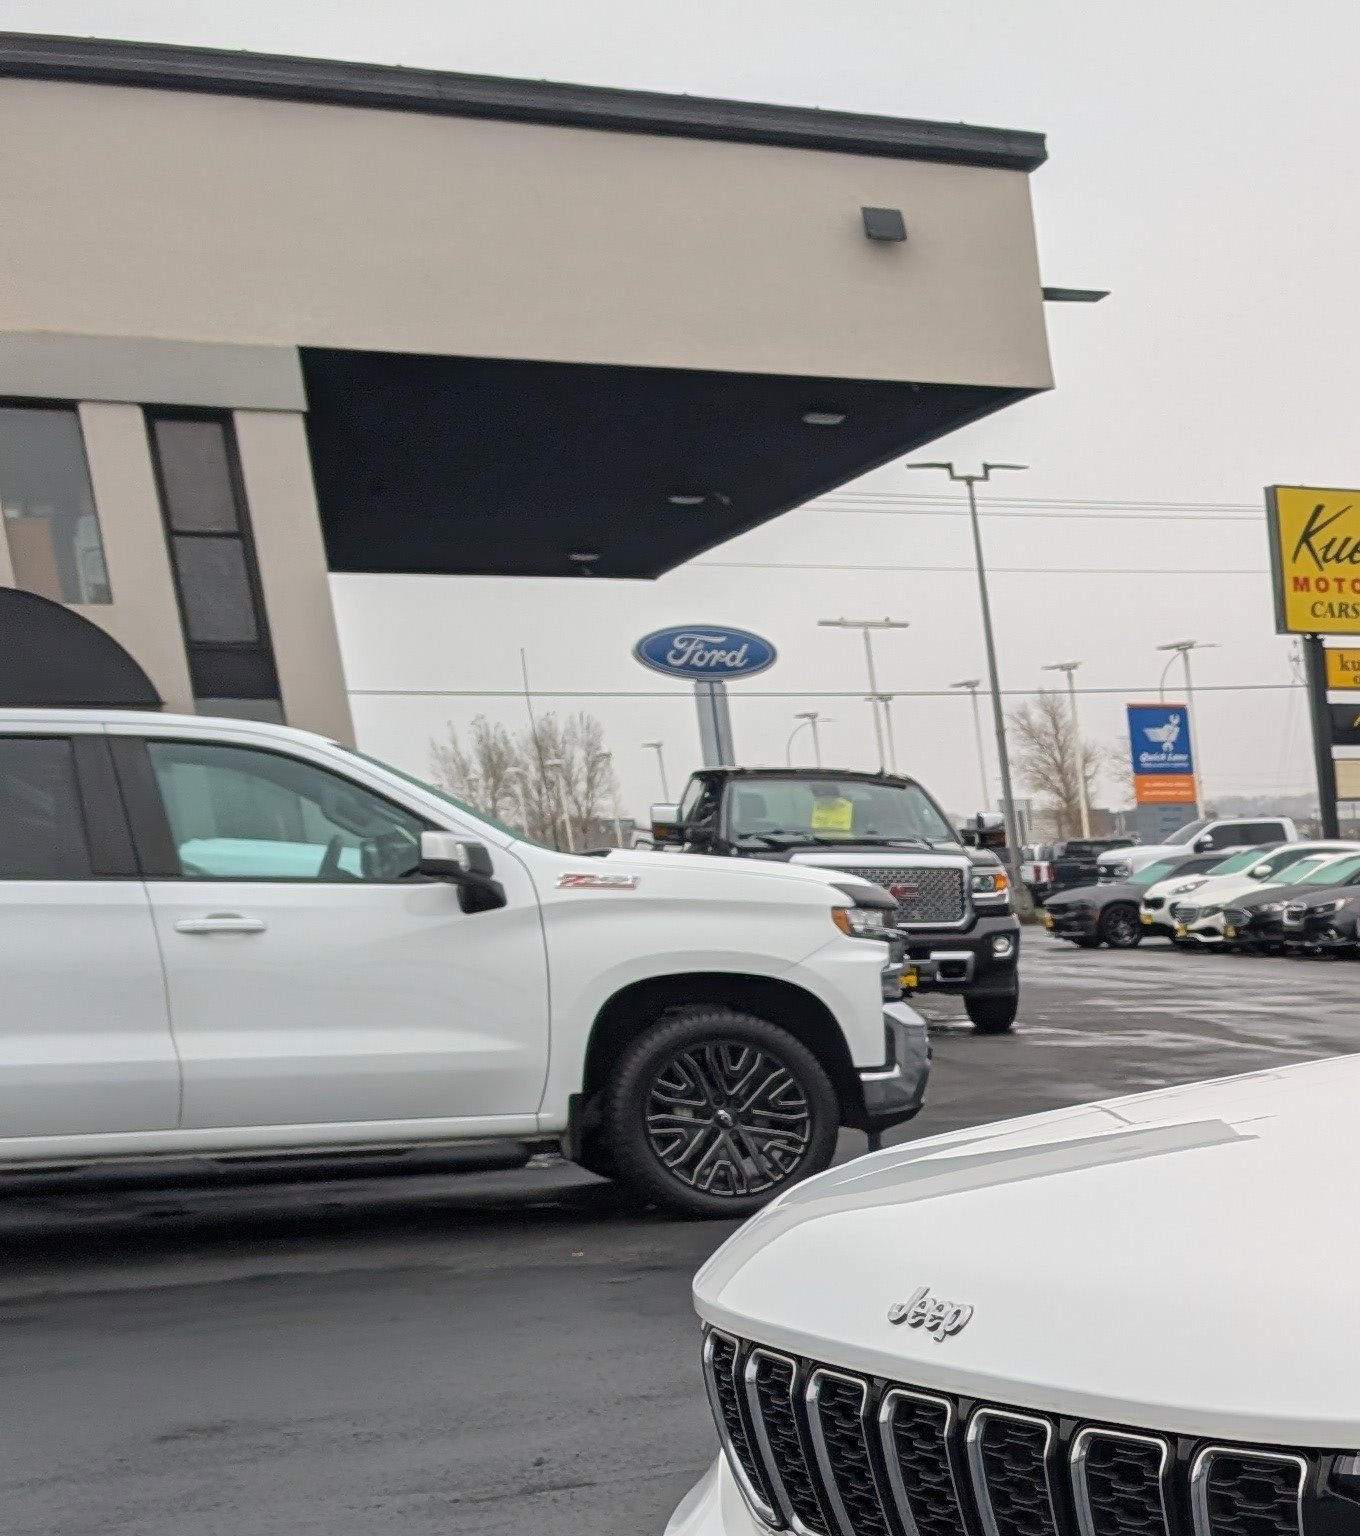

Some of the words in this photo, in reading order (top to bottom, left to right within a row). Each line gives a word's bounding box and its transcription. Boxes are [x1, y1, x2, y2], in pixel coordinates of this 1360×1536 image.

[1310, 600, 1360, 620] CARS
[666, 633, 749, 668] Ford
[887, 1286, 974, 1342] Jeep
